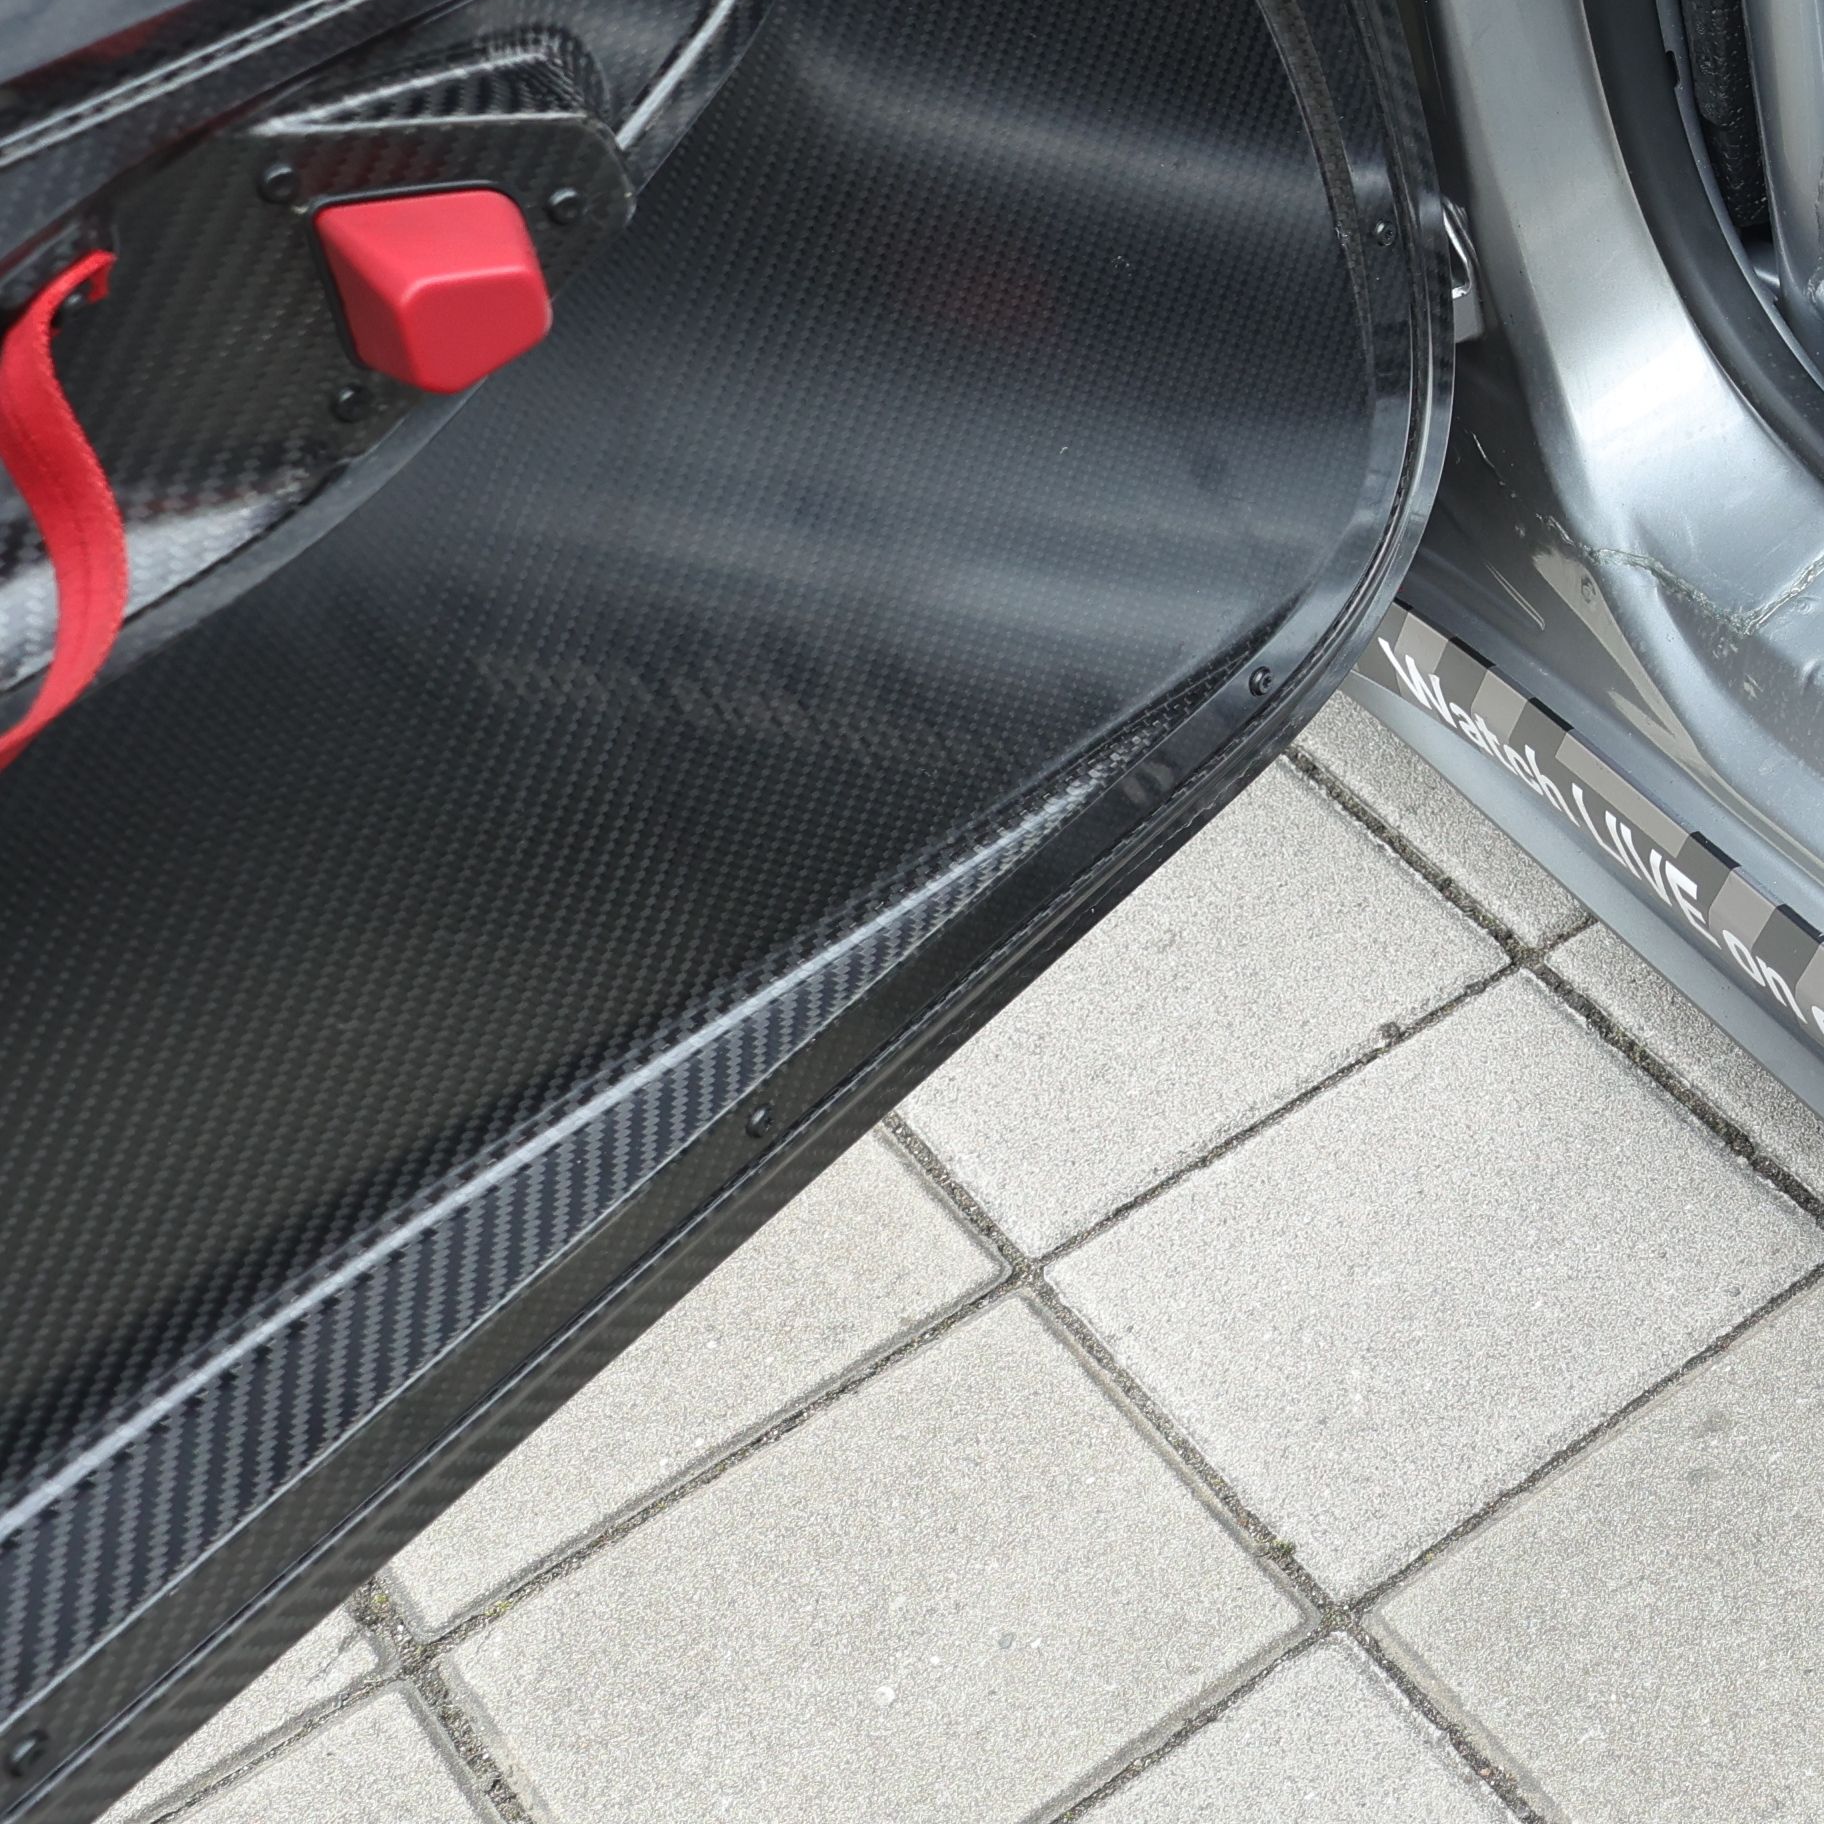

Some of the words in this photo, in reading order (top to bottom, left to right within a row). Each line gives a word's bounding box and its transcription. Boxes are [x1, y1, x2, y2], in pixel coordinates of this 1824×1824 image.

[1378, 636, 1580, 829] Watch
[1571, 782, 1721, 951] LIVE
[1722, 929, 1807, 1024] on
